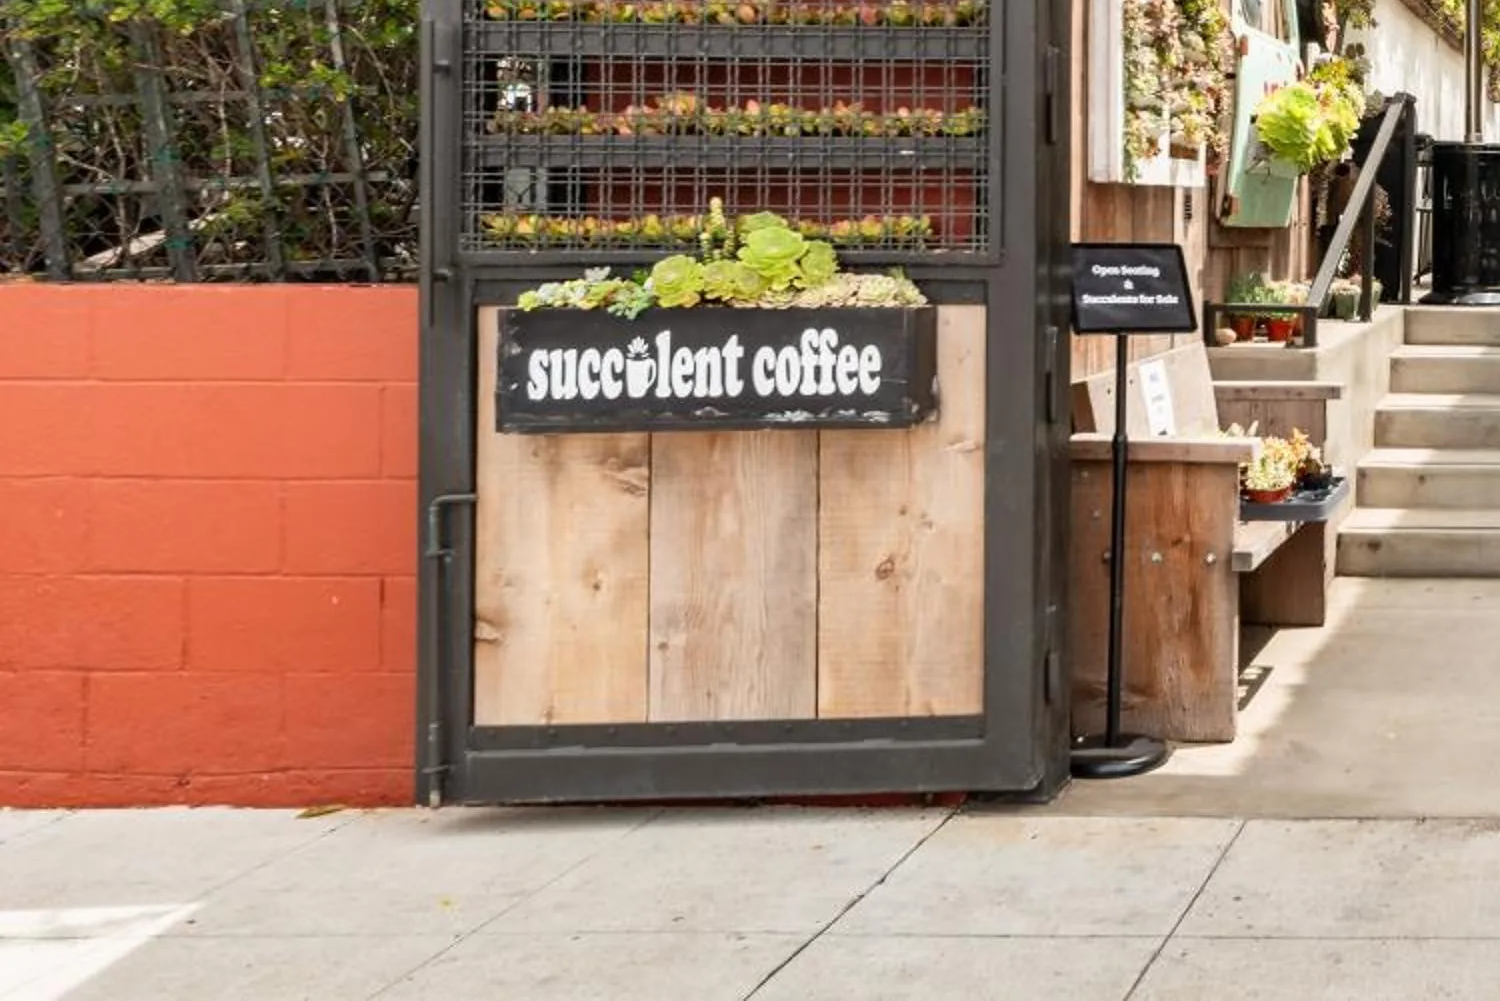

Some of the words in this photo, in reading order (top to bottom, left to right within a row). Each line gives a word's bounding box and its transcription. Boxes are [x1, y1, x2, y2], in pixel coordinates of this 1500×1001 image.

[1091, 264, 1120, 277] Open
[1121, 264, 1160, 277] Seating
[752, 327, 882, 397] coffee
